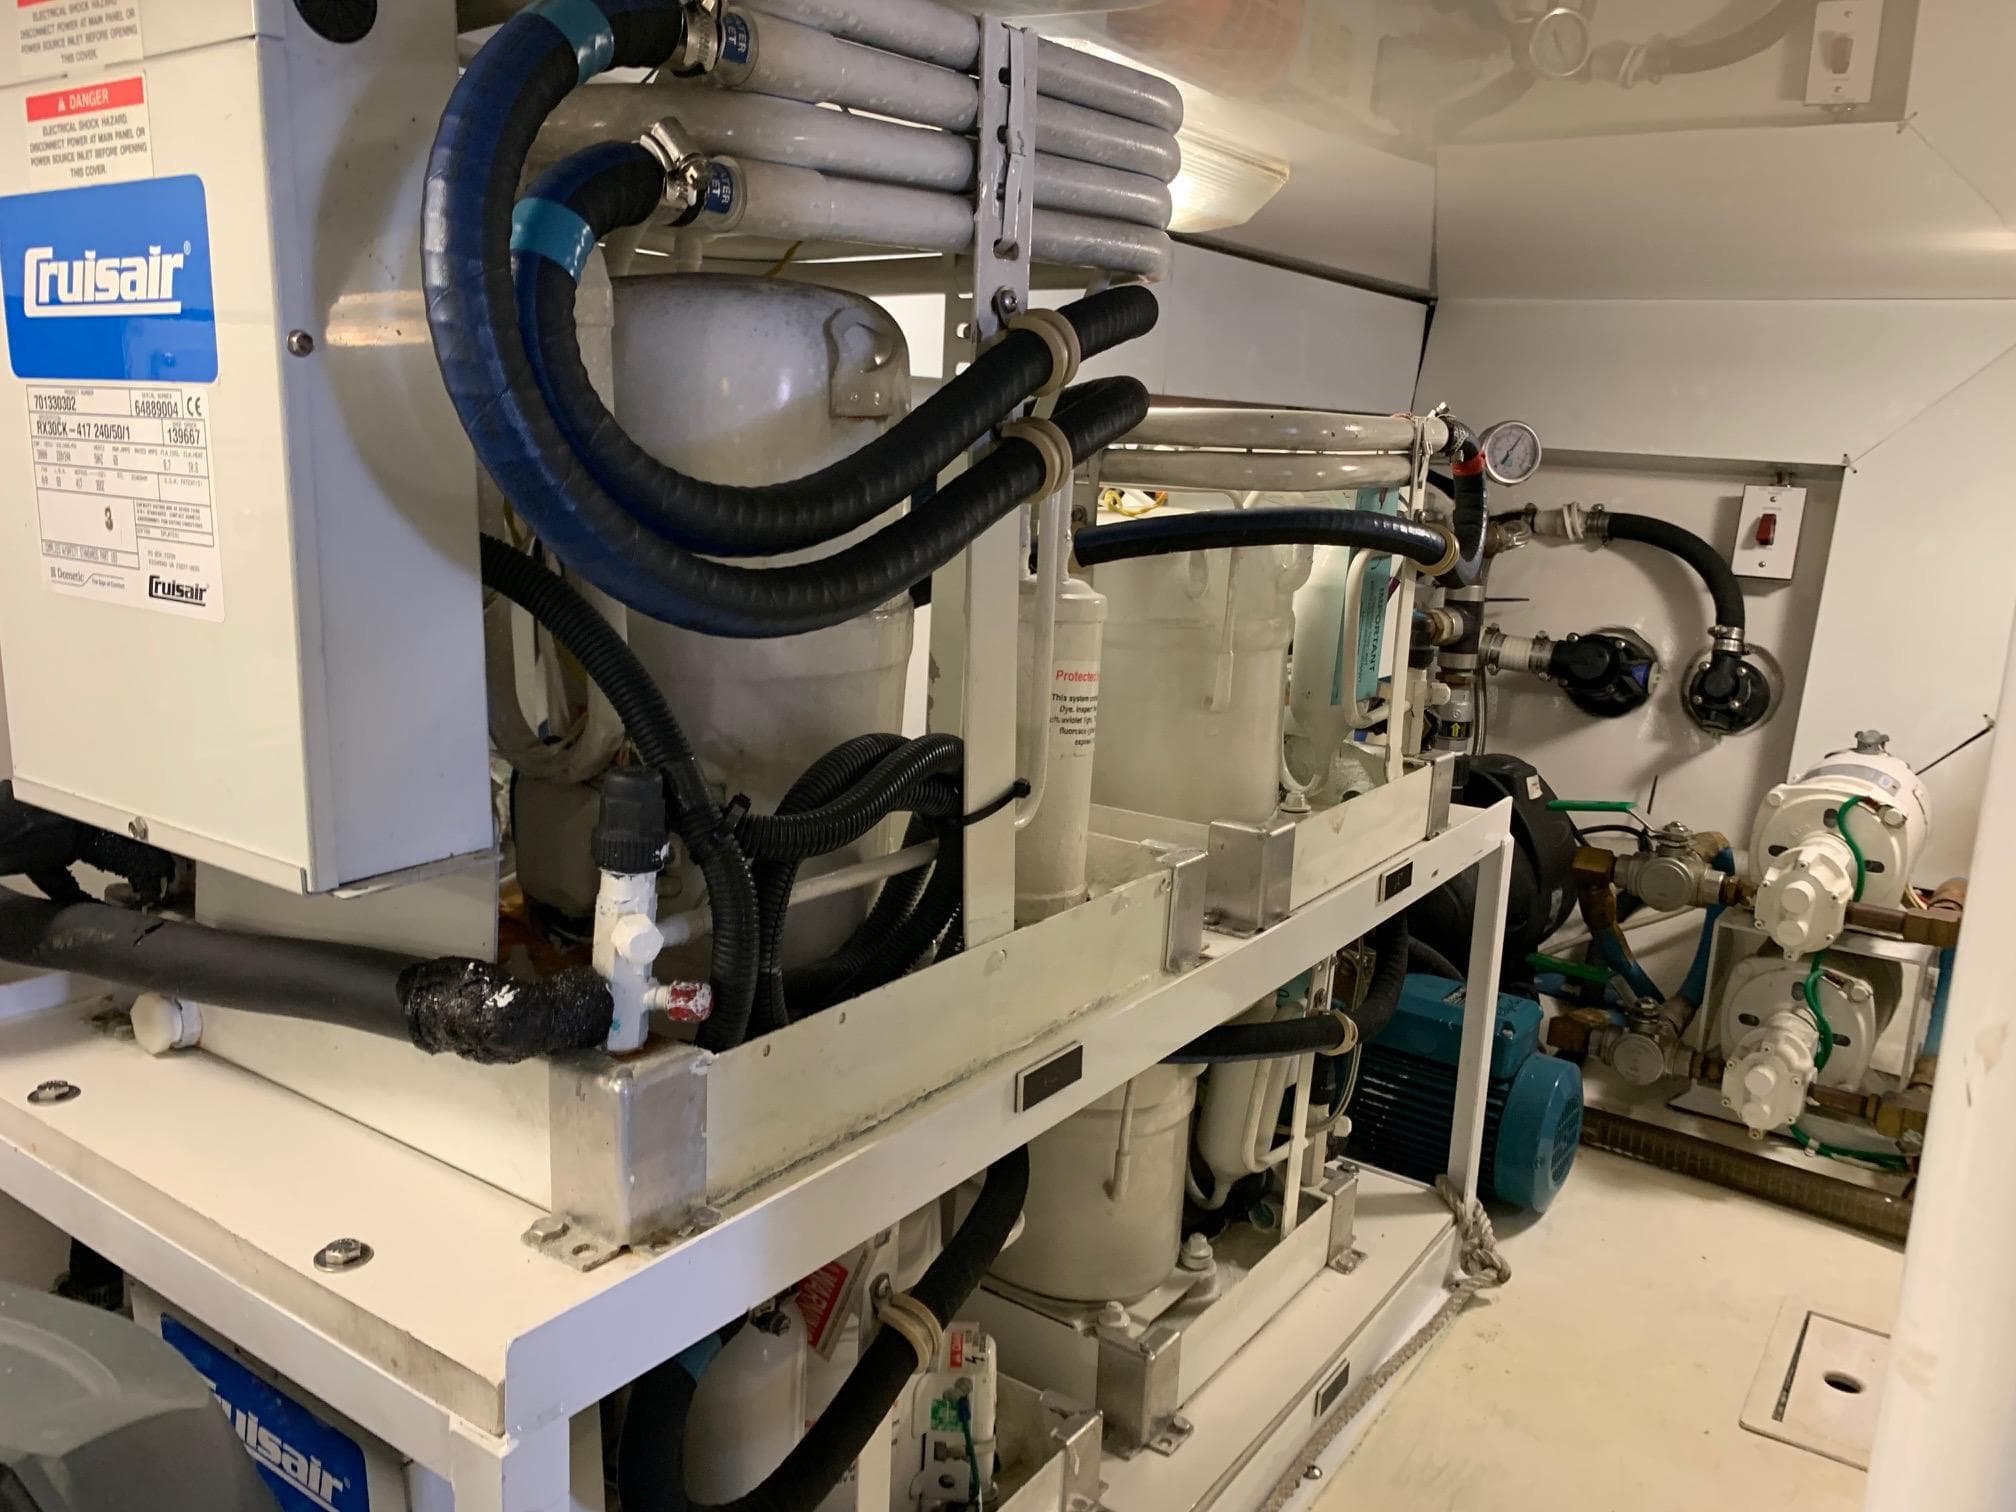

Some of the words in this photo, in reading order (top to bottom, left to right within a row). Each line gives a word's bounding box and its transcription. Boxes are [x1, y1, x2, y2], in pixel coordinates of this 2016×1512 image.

[57, 20, 78, 32] POWER
[105, 10, 124, 22] PANEL
[69, 88, 109, 110] DANGER
[42, 122, 76, 137] ELECTRICAL
[78, 118, 99, 131] SHOCK
[101, 113, 128, 126] HAZARD
[30, 138, 64, 153] DISCONNECT
[67, 135, 87, 147] POWER
[90, 134, 97, 144] AT
[98, 132, 113, 143] MAIN
[115, 128, 134, 140] PANEL
[136, 126, 146, 138] OR
[31, 155, 51, 166] POWER
[52, 152, 75, 165] SOURCE
[77, 149, 93, 161] INLET
[95, 146, 118, 159] BEFORE
[120, 142, 147, 155] OPENING
[70, 168, 84, 178] THIS
[34, 395, 76, 411] 701330302
[134, 399, 179, 417] 64889004
[168, 428, 200, 445] 139667
[104, 505, 114, 531] 3
[57, 568, 84, 583] Dometic
[149, 575, 207, 607] Cruisair
[1369, 587, 1384, 672] IMPORTANT
[1052, 693, 1067, 702] This
